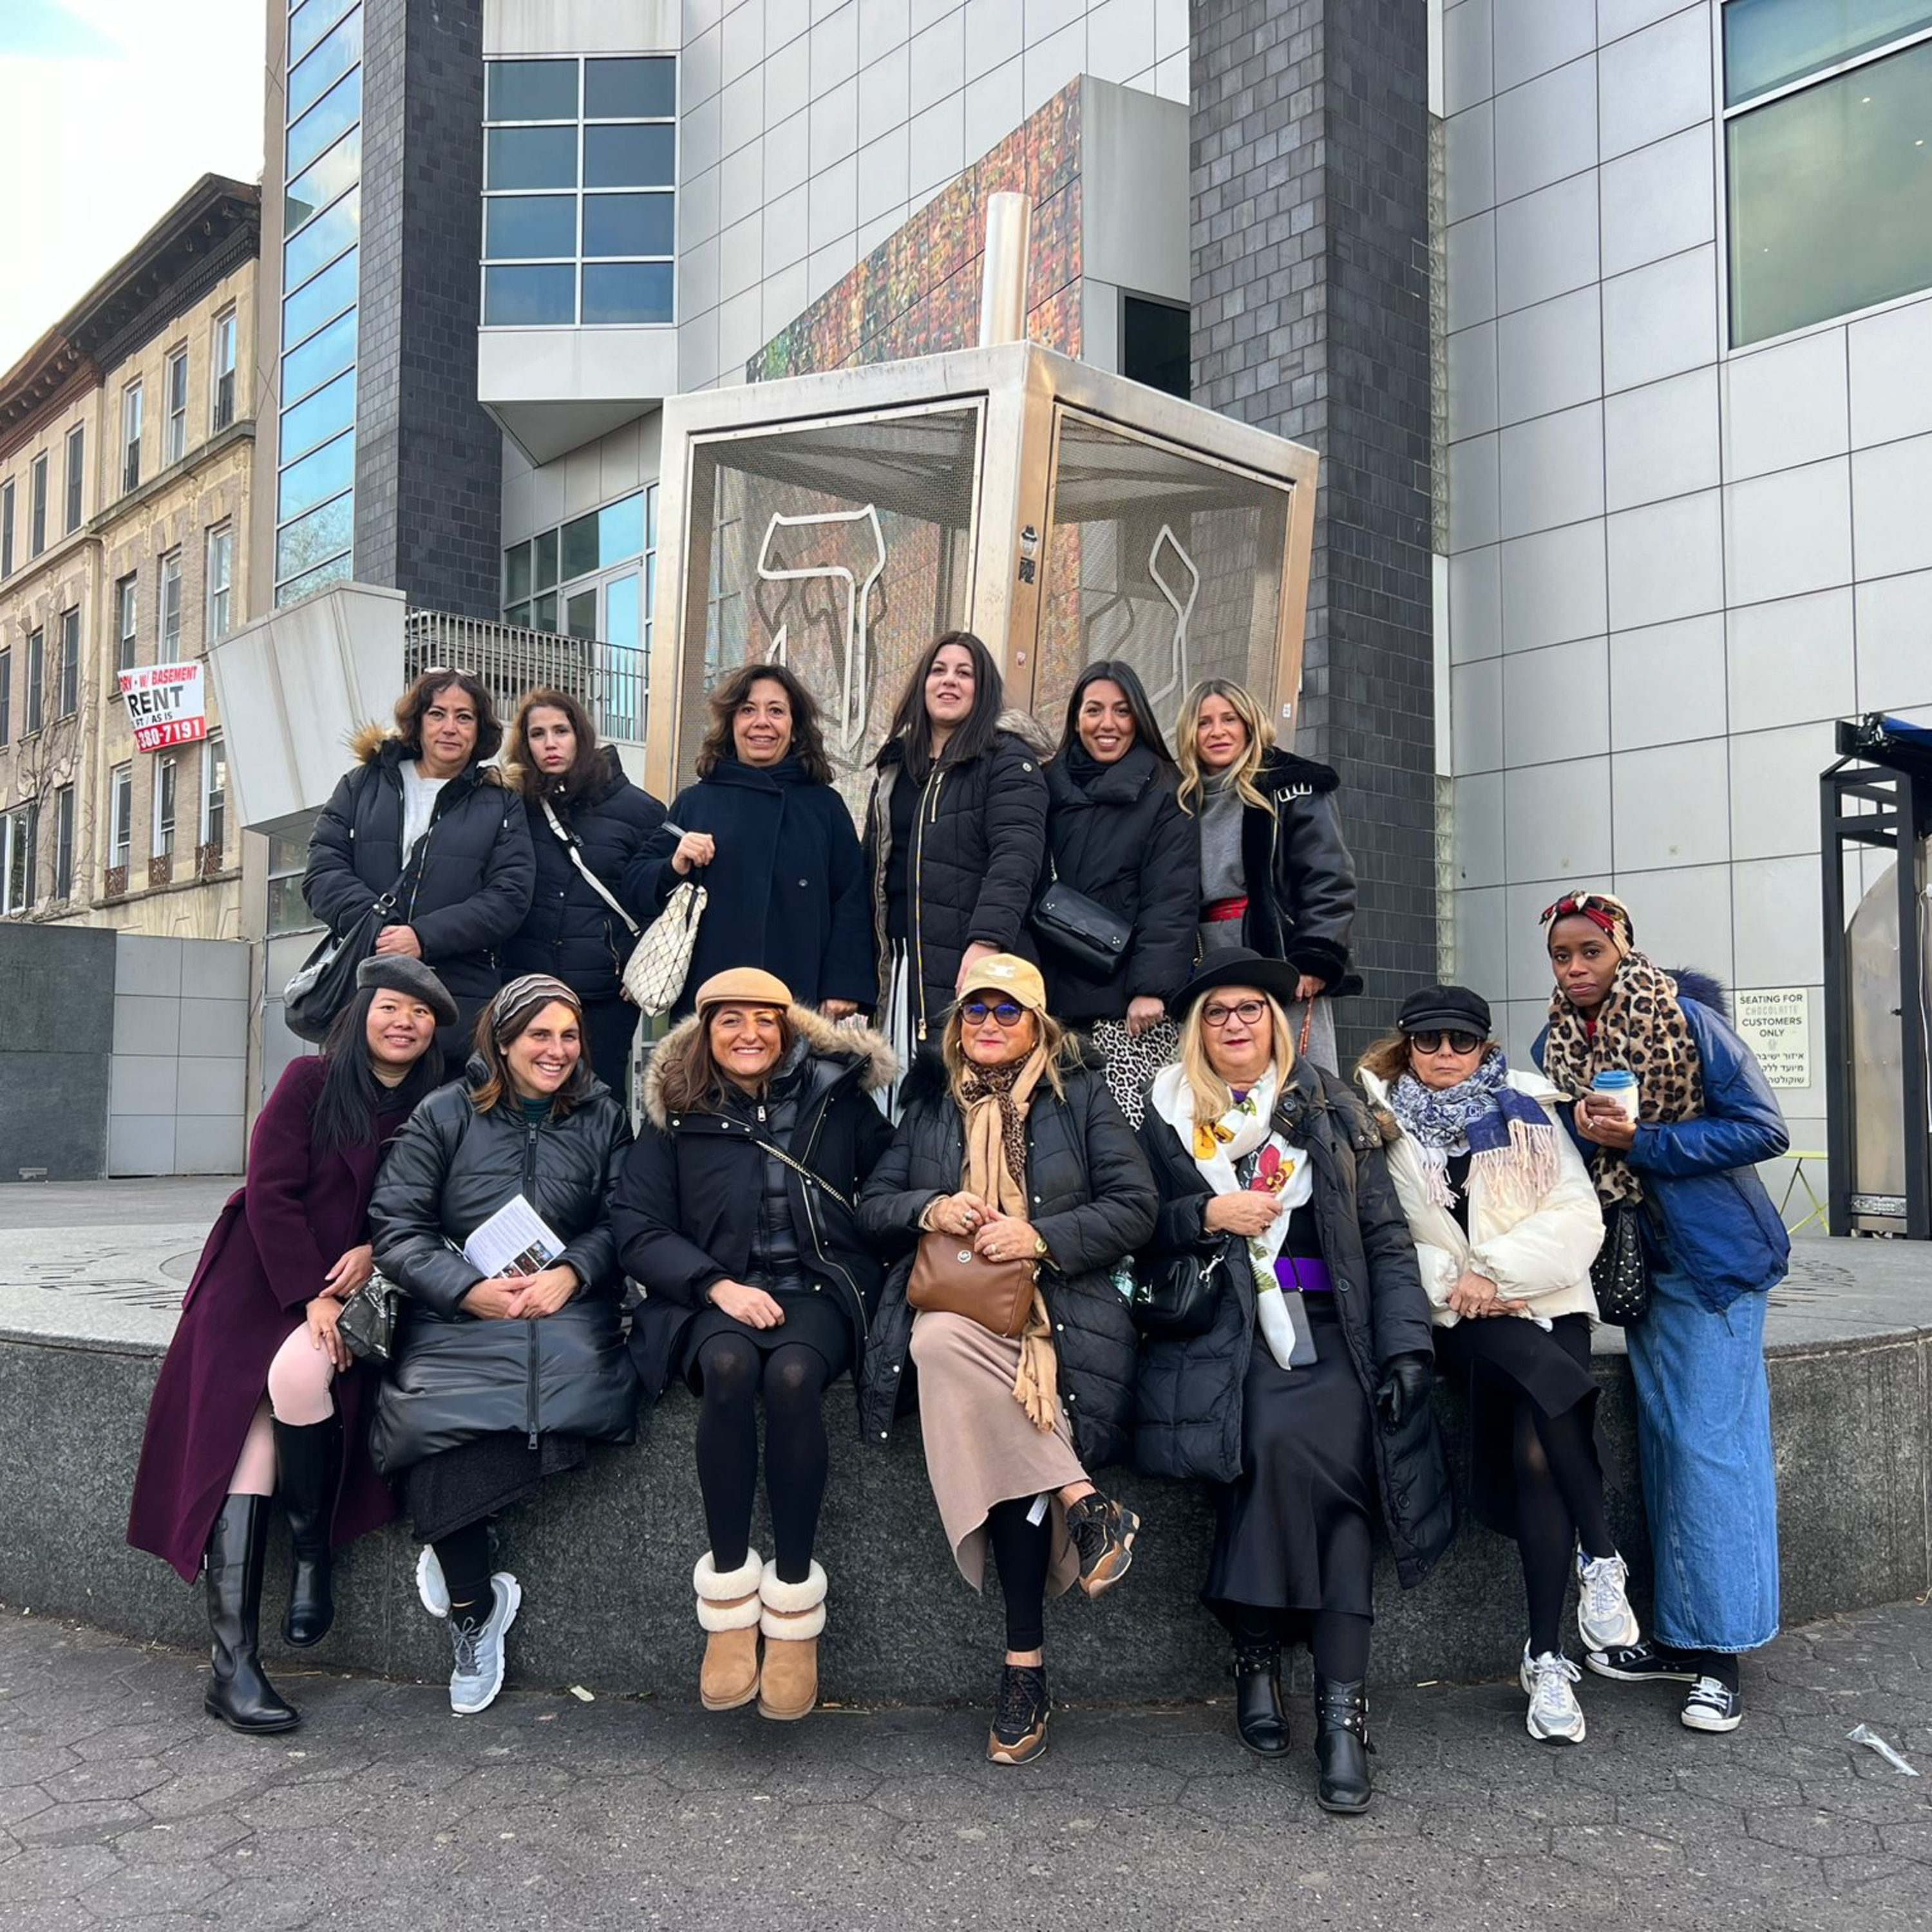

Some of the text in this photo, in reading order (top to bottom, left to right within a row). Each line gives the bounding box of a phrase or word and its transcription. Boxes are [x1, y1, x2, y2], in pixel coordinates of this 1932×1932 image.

[152, 665, 198, 686] BASEMENT
[128, 685, 184, 717] RENT
[151, 713, 162, 723] AS
[164, 712, 173, 721] IS
[1740, 994, 1780, 1004] SEATING
[1741, 1017, 1802, 1027] CUSTOMERS
[1759, 1028, 1785, 1037] ONLY
